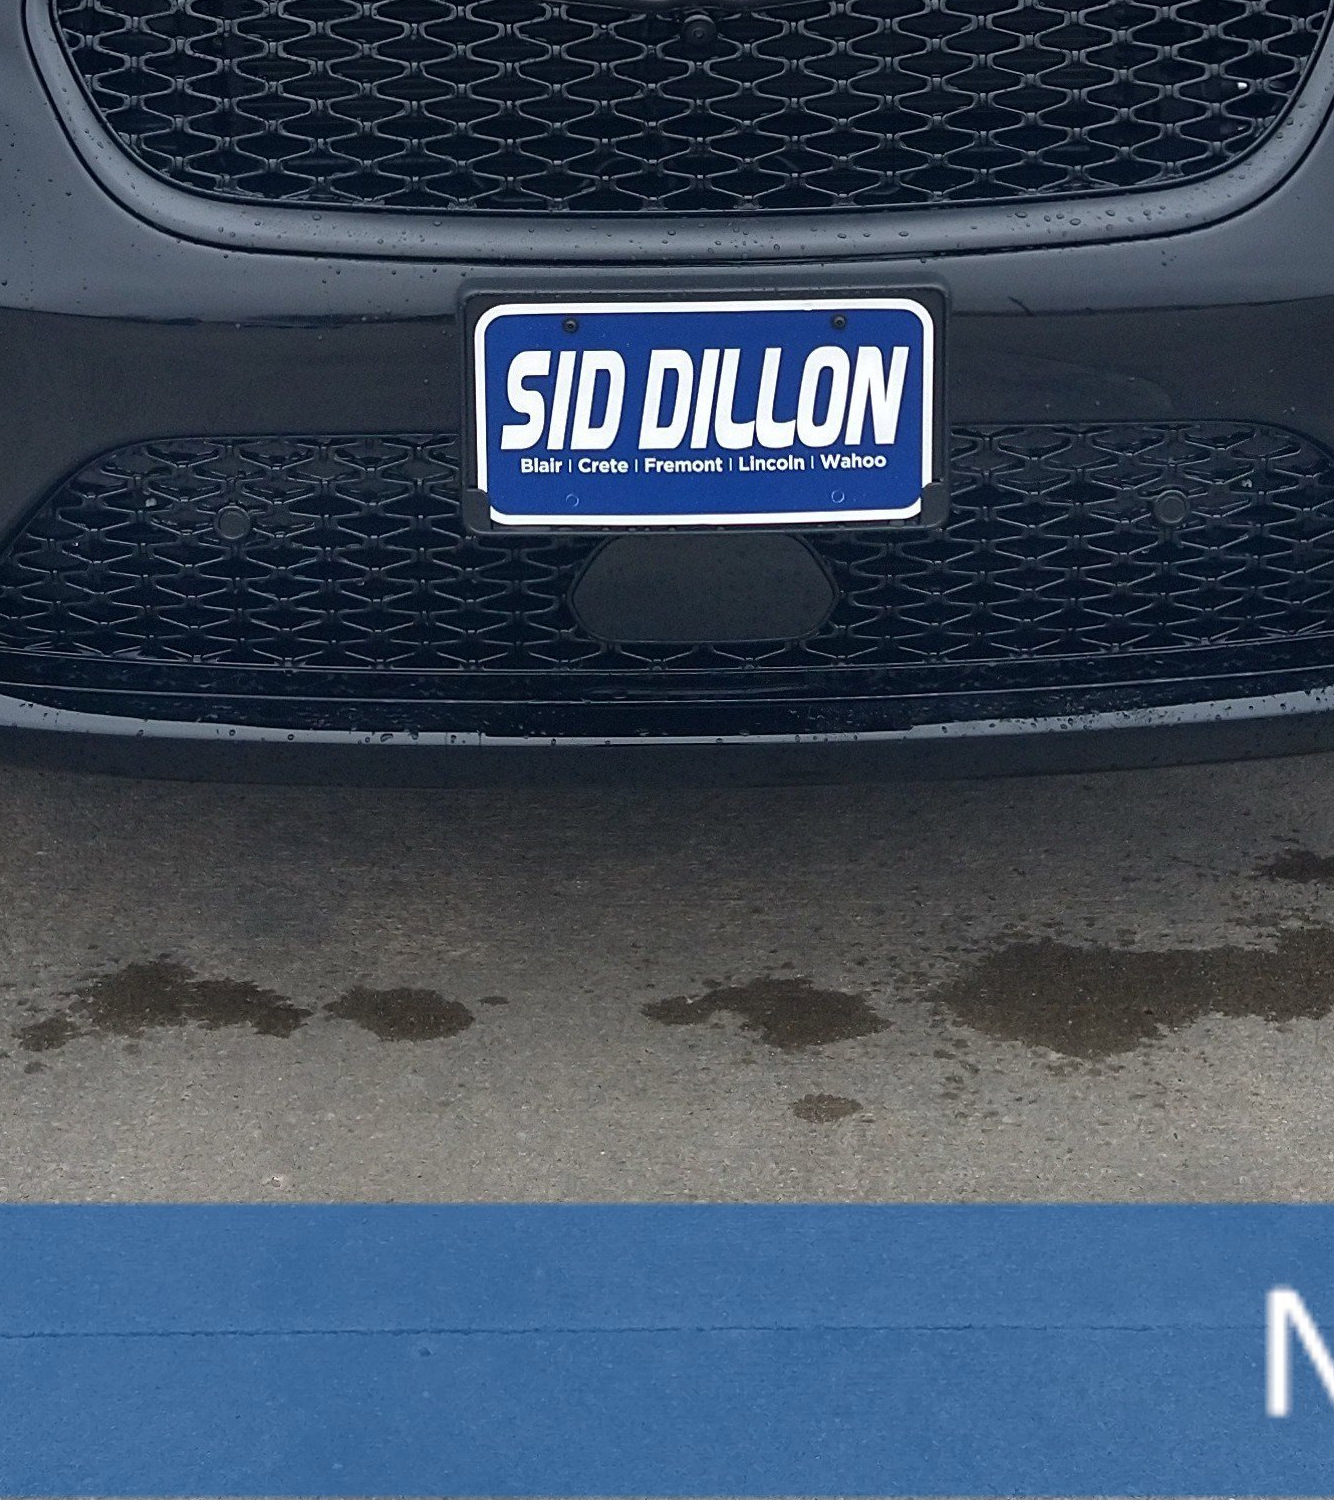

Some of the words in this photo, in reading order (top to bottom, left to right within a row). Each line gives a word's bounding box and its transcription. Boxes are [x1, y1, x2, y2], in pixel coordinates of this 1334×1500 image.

[500, 350, 626, 450] SID
[638, 345, 910, 450] DILLON
[520, 457, 563, 474] Blair
[577, 457, 629, 473] Crete
[644, 456, 723, 474] Fremont
[738, 454, 805, 472] Lincoln
[820, 452, 887, 470] Wahoo
